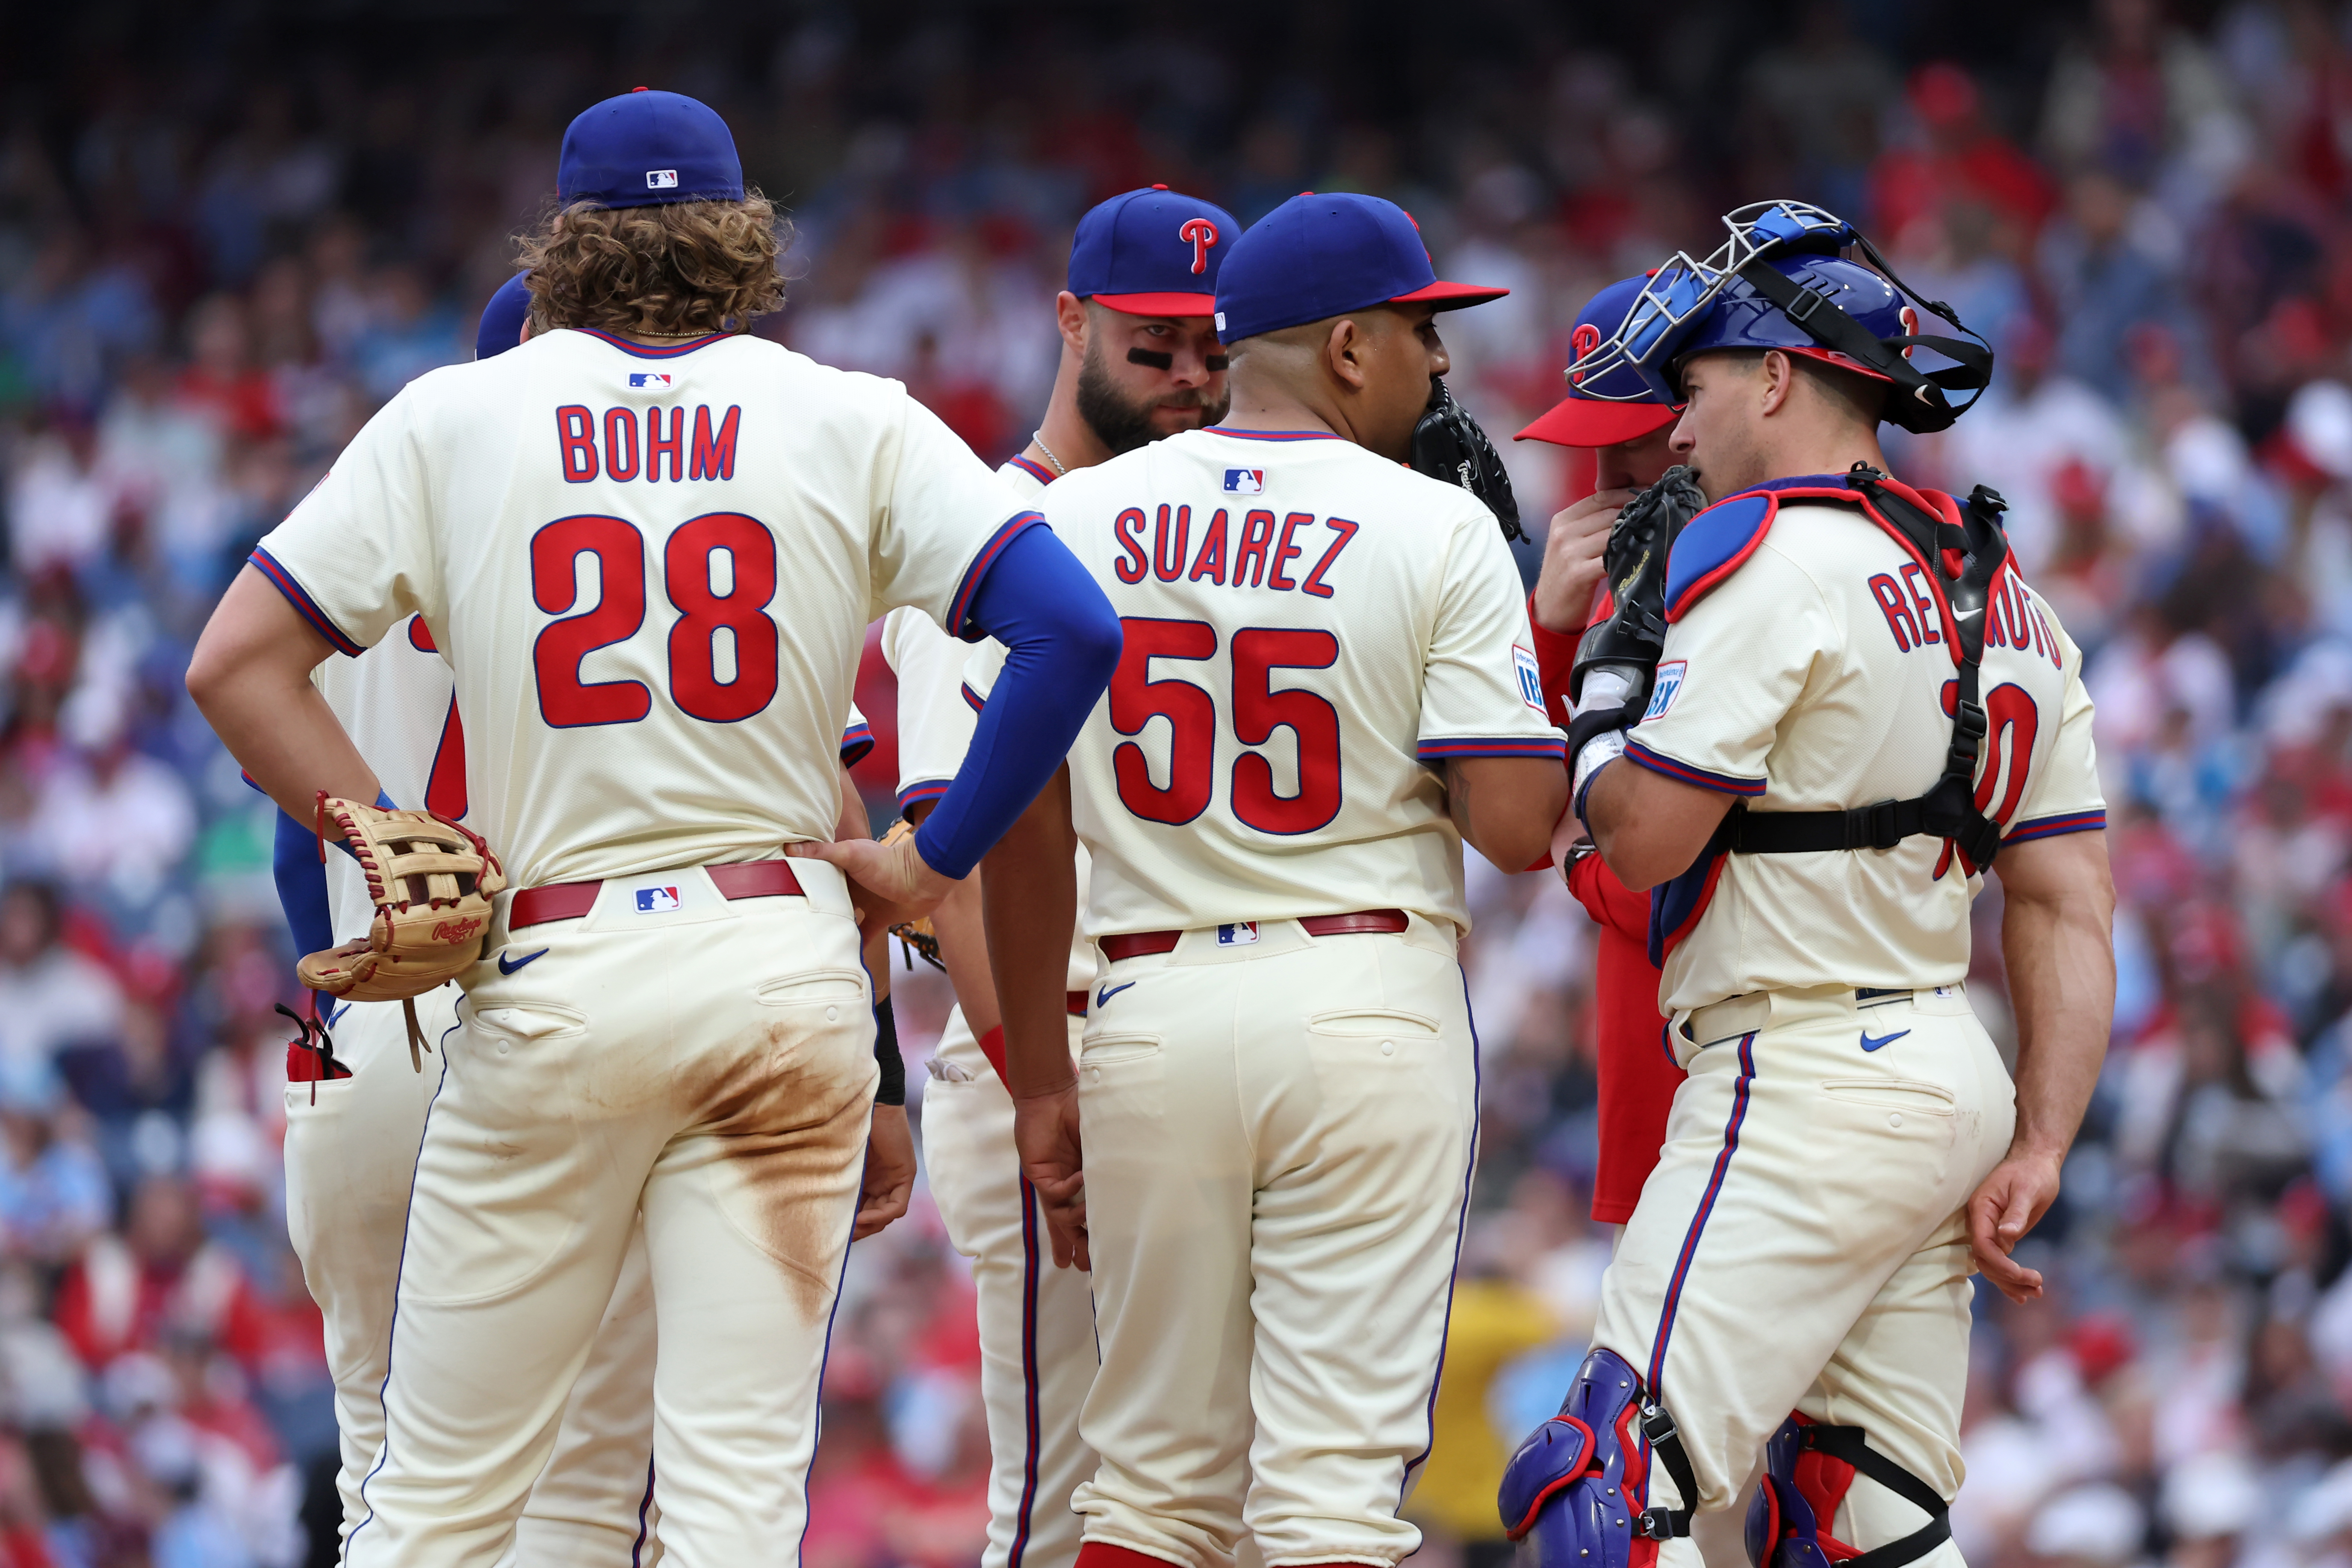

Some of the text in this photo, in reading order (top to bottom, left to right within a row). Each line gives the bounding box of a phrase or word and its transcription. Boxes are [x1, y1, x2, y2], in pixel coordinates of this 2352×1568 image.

[1179, 218, 1219, 275] P
[1571, 323, 1601, 383] P
[556, 404, 741, 483] BOHM
[1114, 503, 1359, 599] SUAREZ
[530, 511, 778, 729] 28
[1518, 665, 1546, 709] IB
[1643, 680, 1679, 718] BX
[1108, 616, 1343, 836] 55
